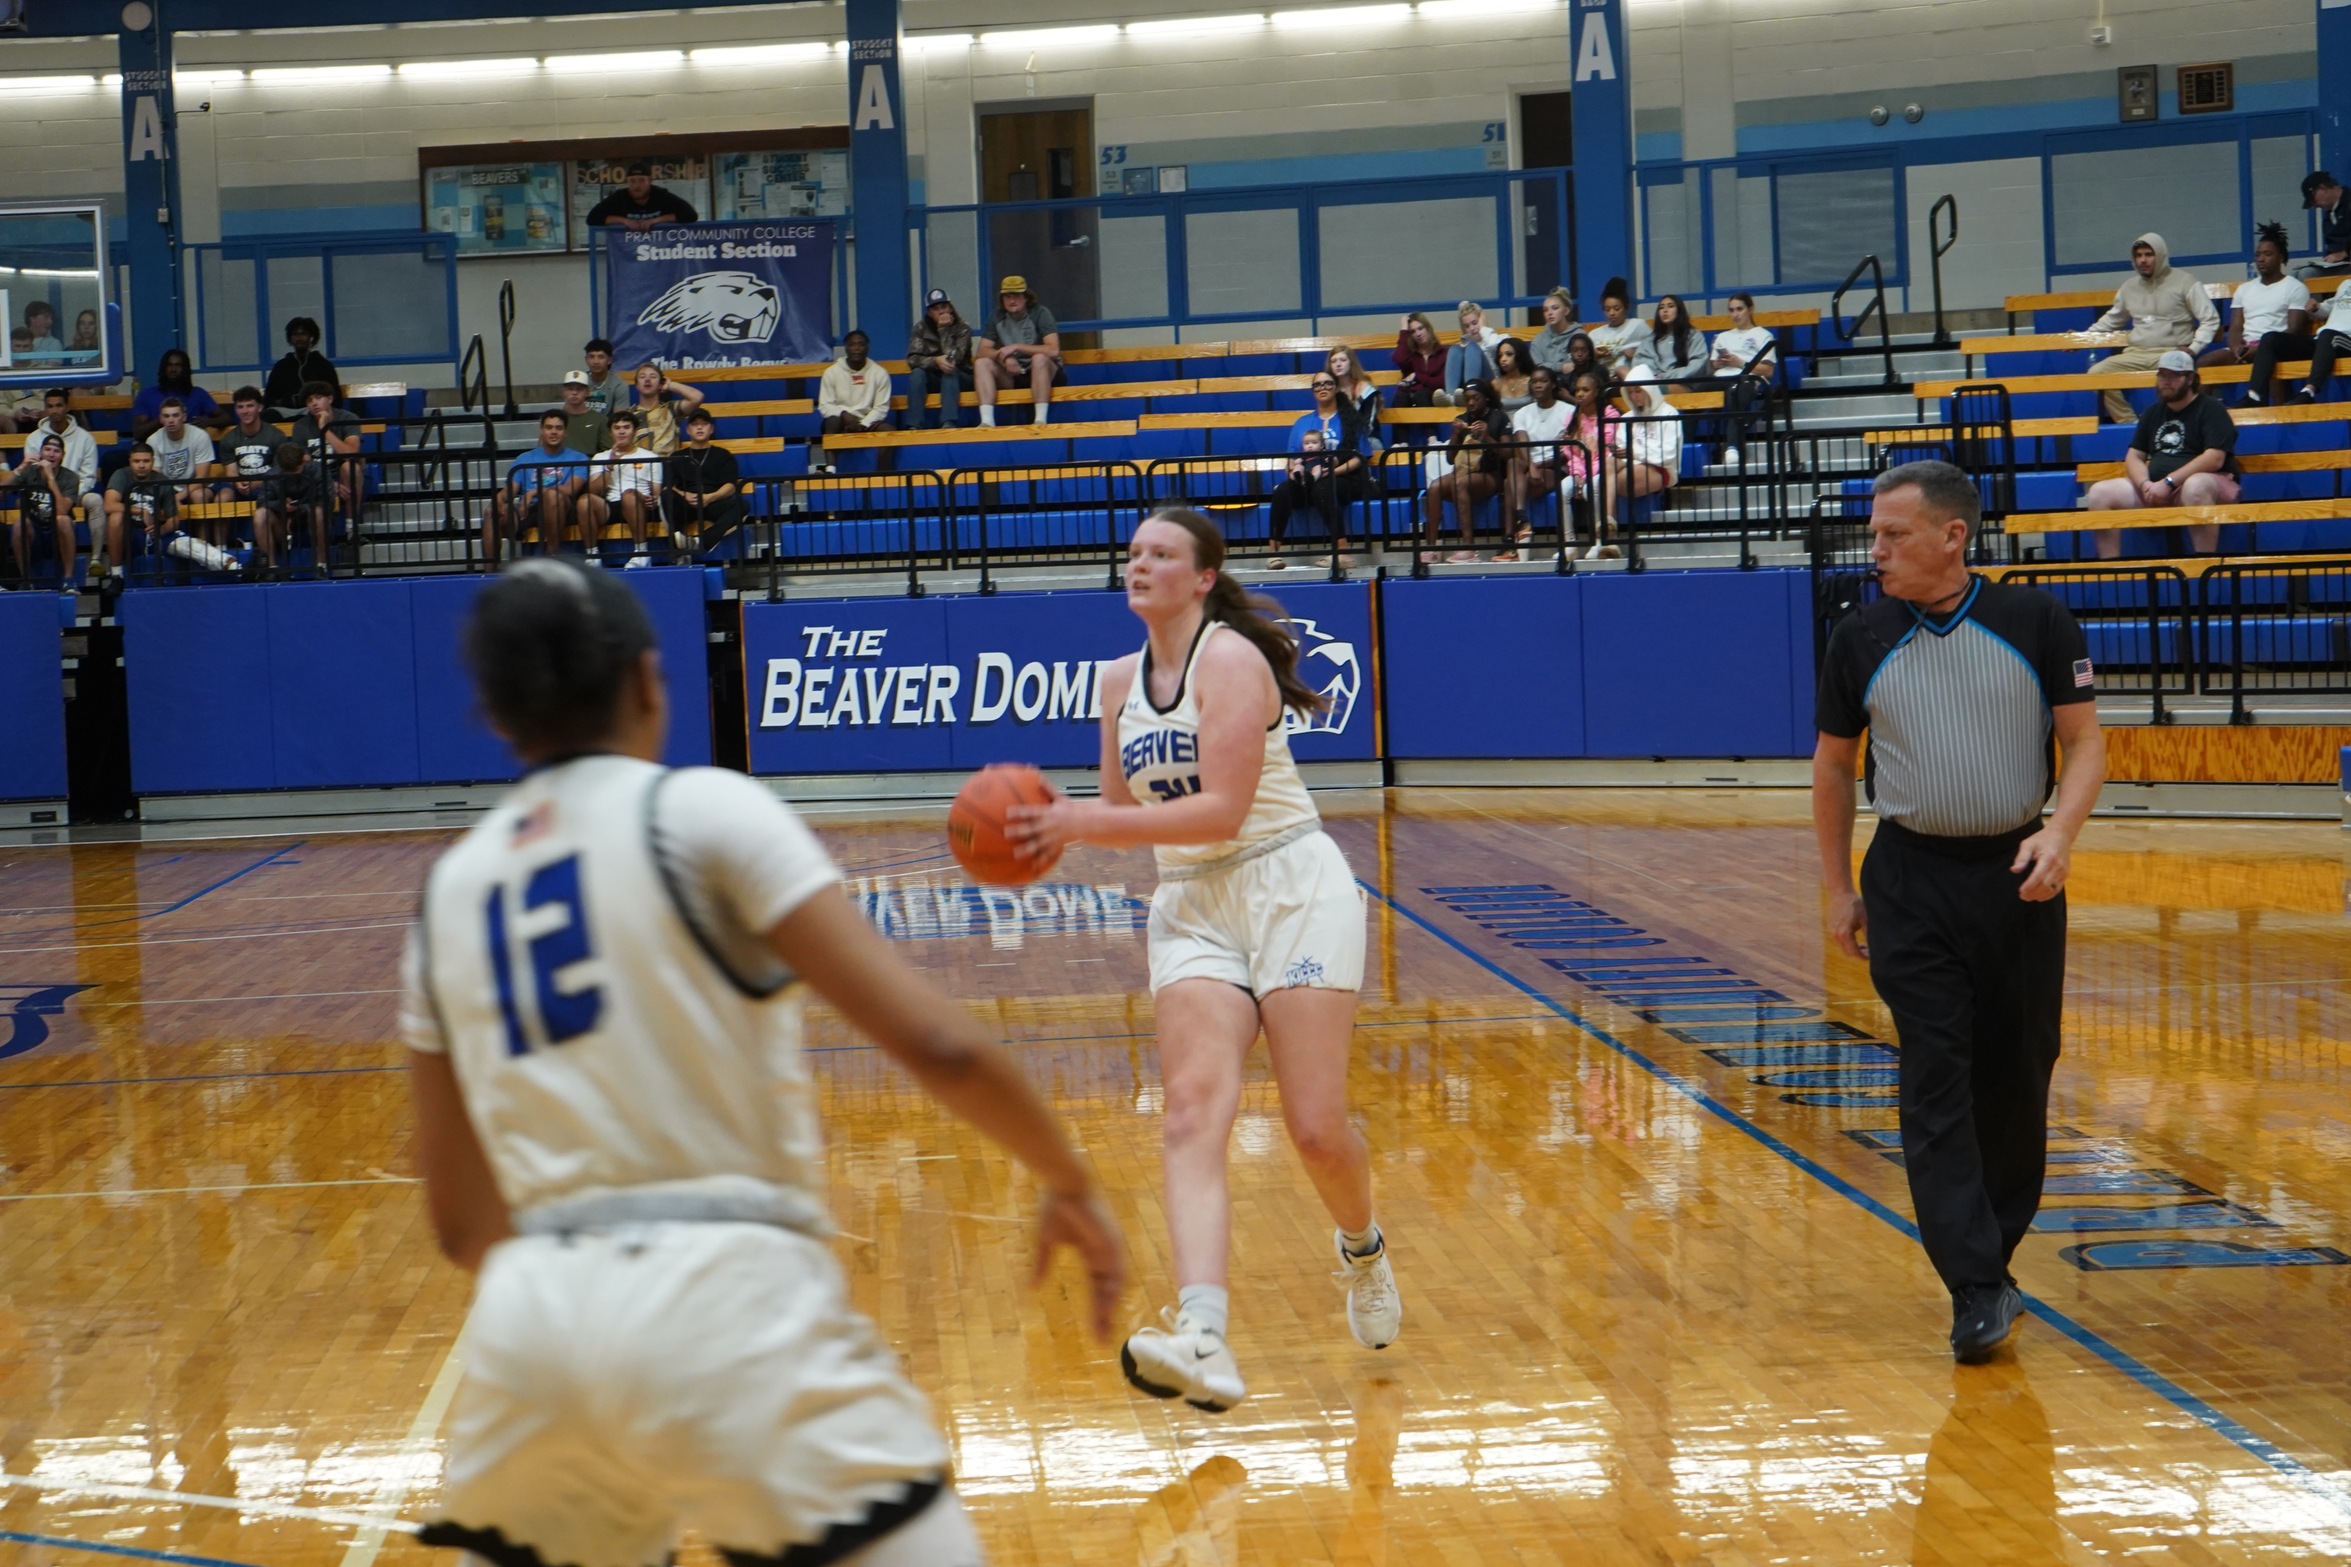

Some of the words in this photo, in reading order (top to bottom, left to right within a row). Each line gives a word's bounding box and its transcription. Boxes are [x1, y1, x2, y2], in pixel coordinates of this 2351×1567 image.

[853, 49, 892, 60] SECTION
[1575, 11, 1617, 81] A
[854, 64, 895, 130] A
[129, 95, 170, 161] A
[1482, 122, 1505, 142] 51
[1101, 146, 1127, 165] 53
[471, 171, 519, 185] BEAVERS
[577, 159, 708, 184] SCHORSHIP
[625, 231, 663, 243] PRATT
[666, 227, 750, 242] COMMUNITY
[753, 226, 816, 239] COLLEGE
[636, 243, 717, 261] Student
[720, 242, 797, 259] Section
[801, 625, 888, 659] THE
[759, 657, 961, 729] BEAVER
[485, 851, 610, 1060] 12
